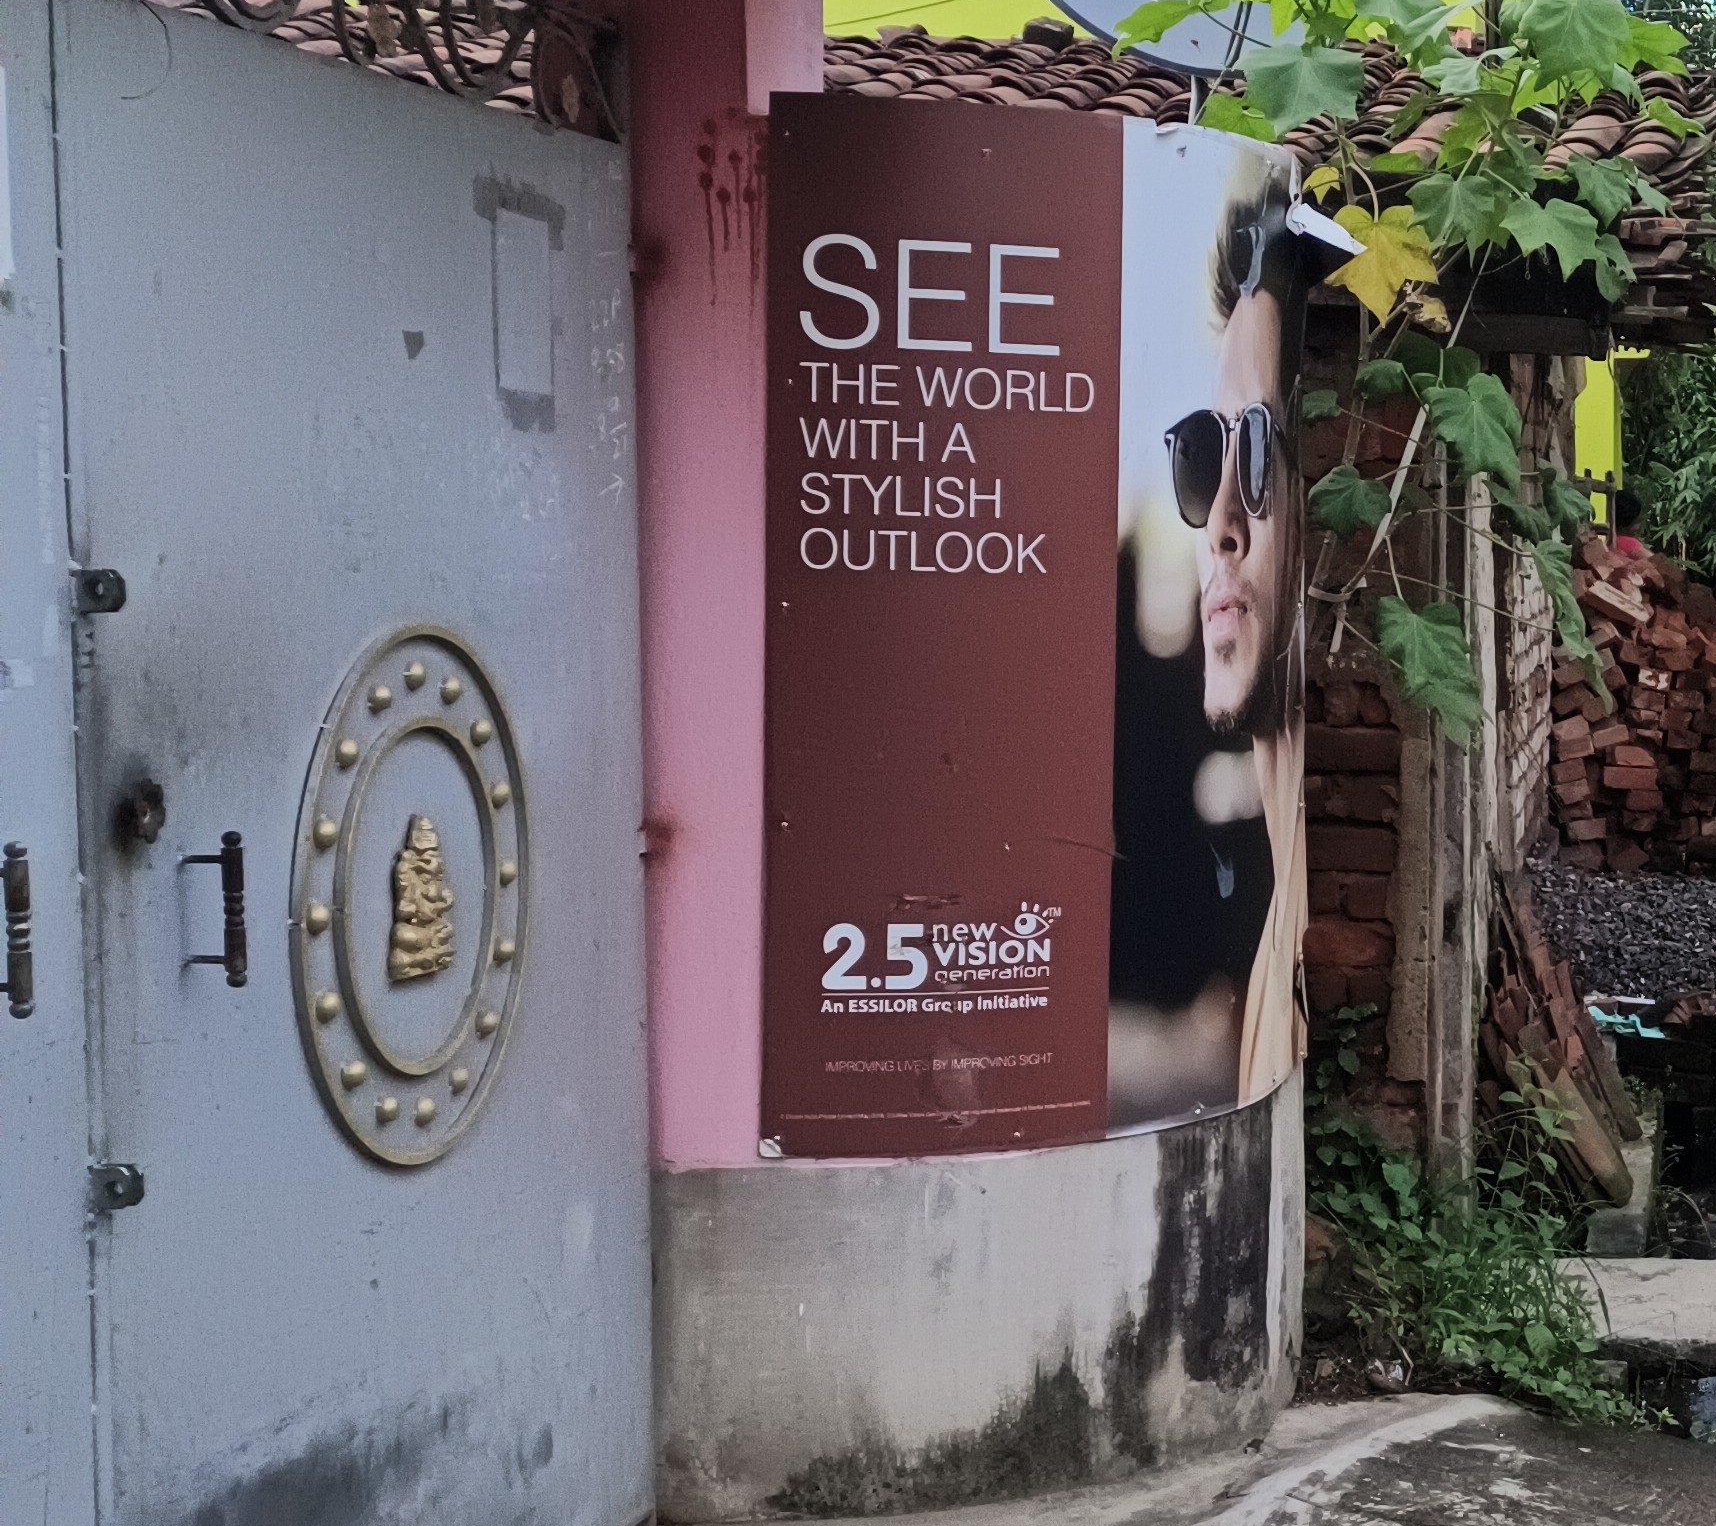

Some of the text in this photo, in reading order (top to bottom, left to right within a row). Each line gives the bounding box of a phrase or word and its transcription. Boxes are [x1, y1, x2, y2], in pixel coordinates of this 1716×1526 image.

[799, 233, 1060, 357] SEE
[799, 361, 1095, 413] THE WORLD
[799, 417, 976, 464] WITH A
[800, 472, 1001, 519] STYLISH
[800, 527, 1047, 574] OUTLOOK
[932, 922, 998, 942] new
[932, 938, 1051, 966] VISION
[821, 922, 928, 990] 2.5
[934, 964, 1050, 984] generation
[820, 999, 844, 1013] An
[848, 998, 918, 1013] ESSILOR
[977, 994, 1049, 1011] Initiative
[825, 1060, 894, 1073] IMPROVING
[932, 1058, 949, 1071] BY
[951, 1055, 1017, 1070] IMPROVING
[1019, 1052, 1054, 1066] SIGHT
